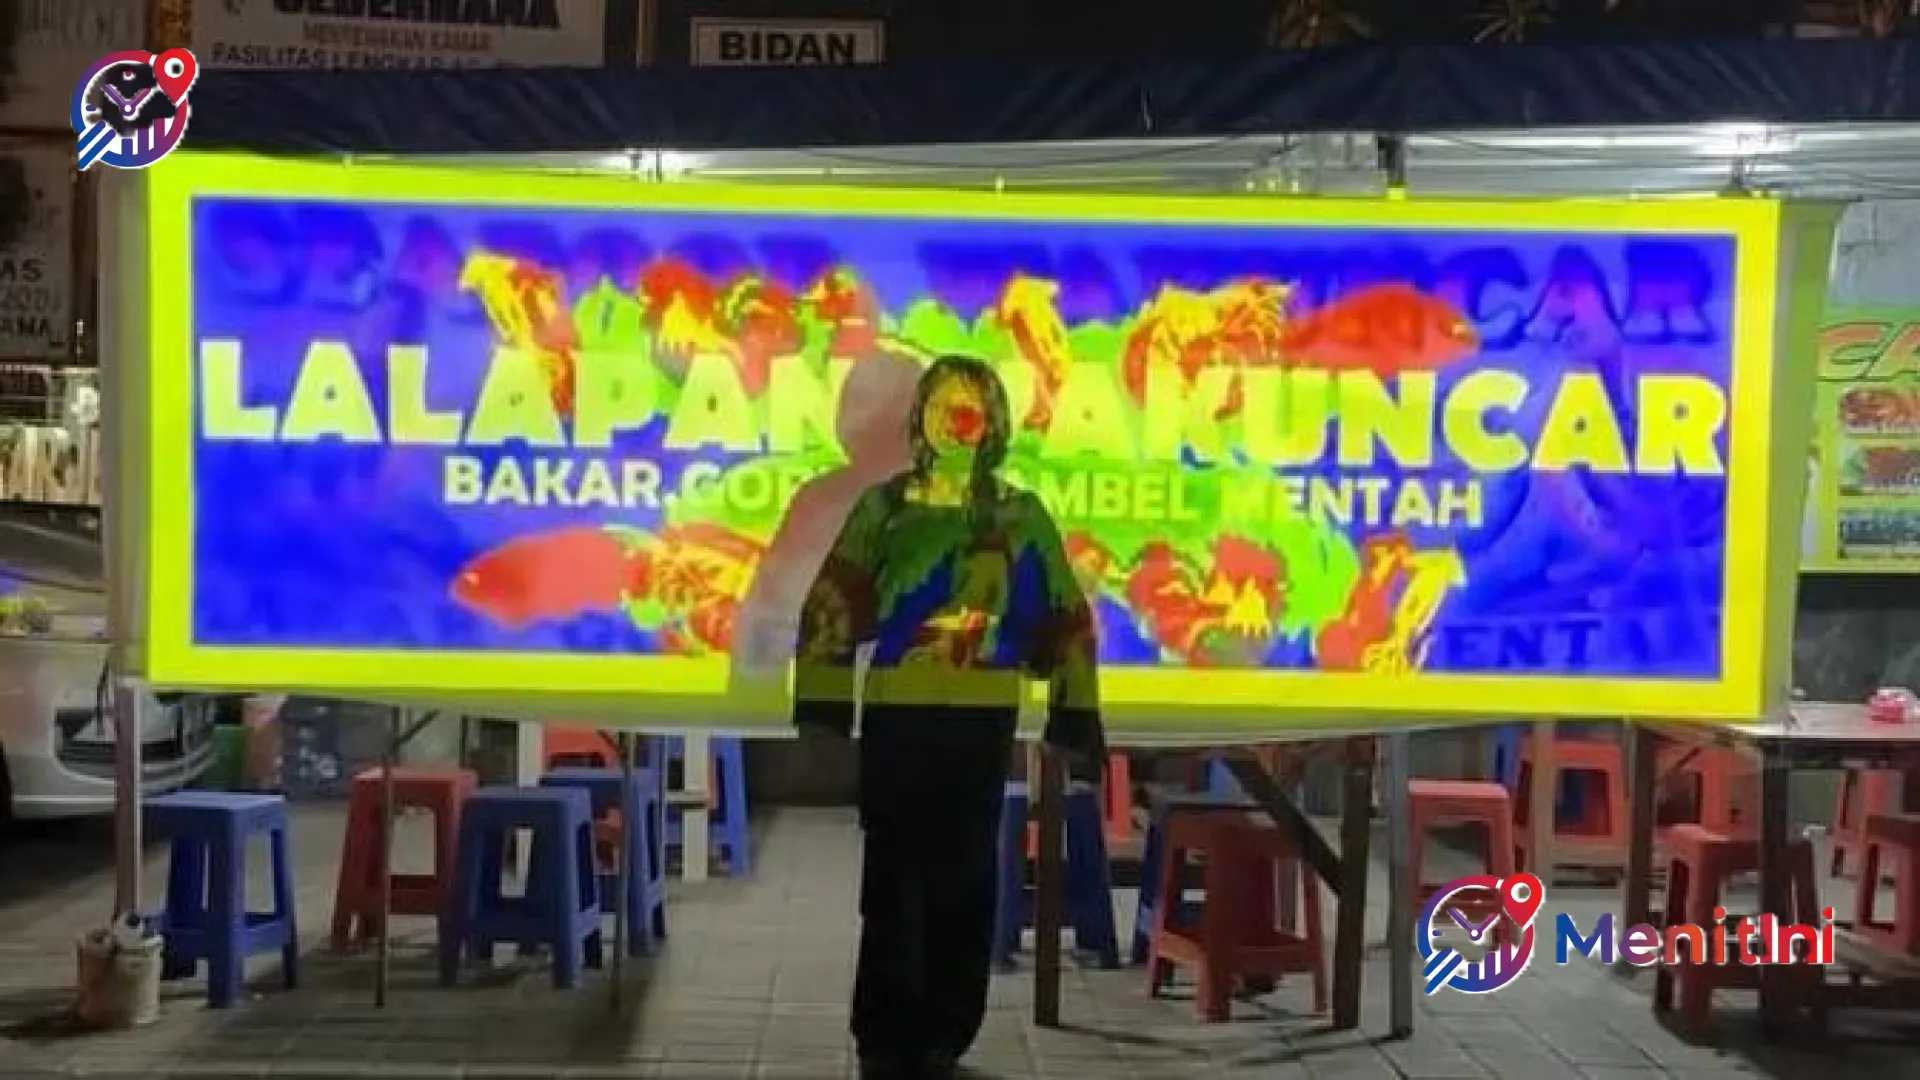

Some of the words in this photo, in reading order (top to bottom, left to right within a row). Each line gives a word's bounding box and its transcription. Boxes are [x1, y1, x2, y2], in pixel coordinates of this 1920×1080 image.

[212, 42, 330, 68] FASILITAS
[718, 31, 857, 65] BIDAN
[200, 339, 855, 453] LALAPAN
[1219, 474, 1485, 528] MENTAH
